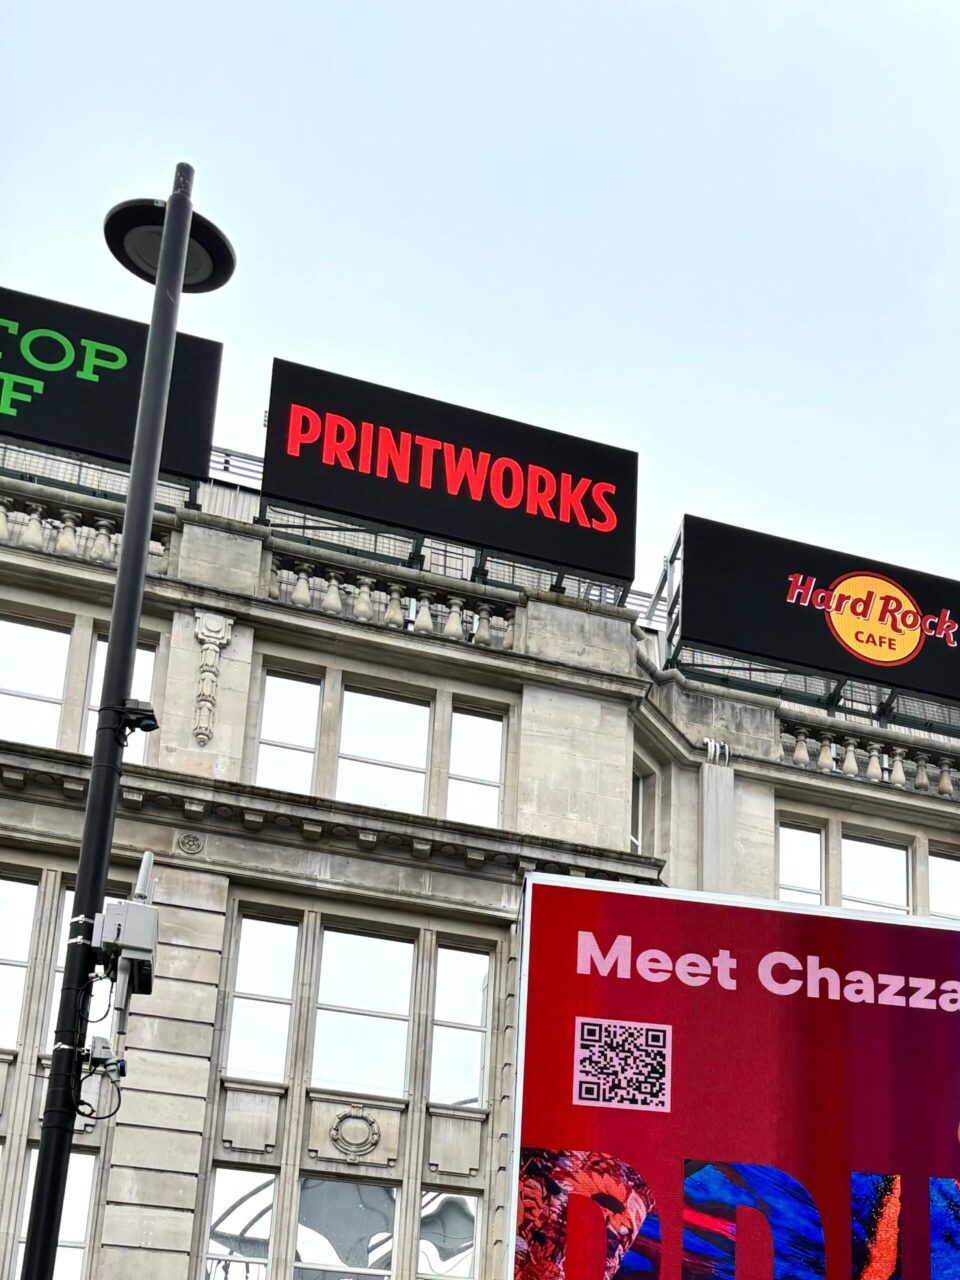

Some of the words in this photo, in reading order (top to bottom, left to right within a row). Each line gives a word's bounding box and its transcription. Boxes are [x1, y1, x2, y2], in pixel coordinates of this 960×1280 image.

[286, 402, 618, 533] PRINTWORKS
[786, 573, 875, 621] Hard
[878, 587, 958, 647] Rock
[854, 630, 897, 651] CAFE
[576, 930, 737, 991] Meet
